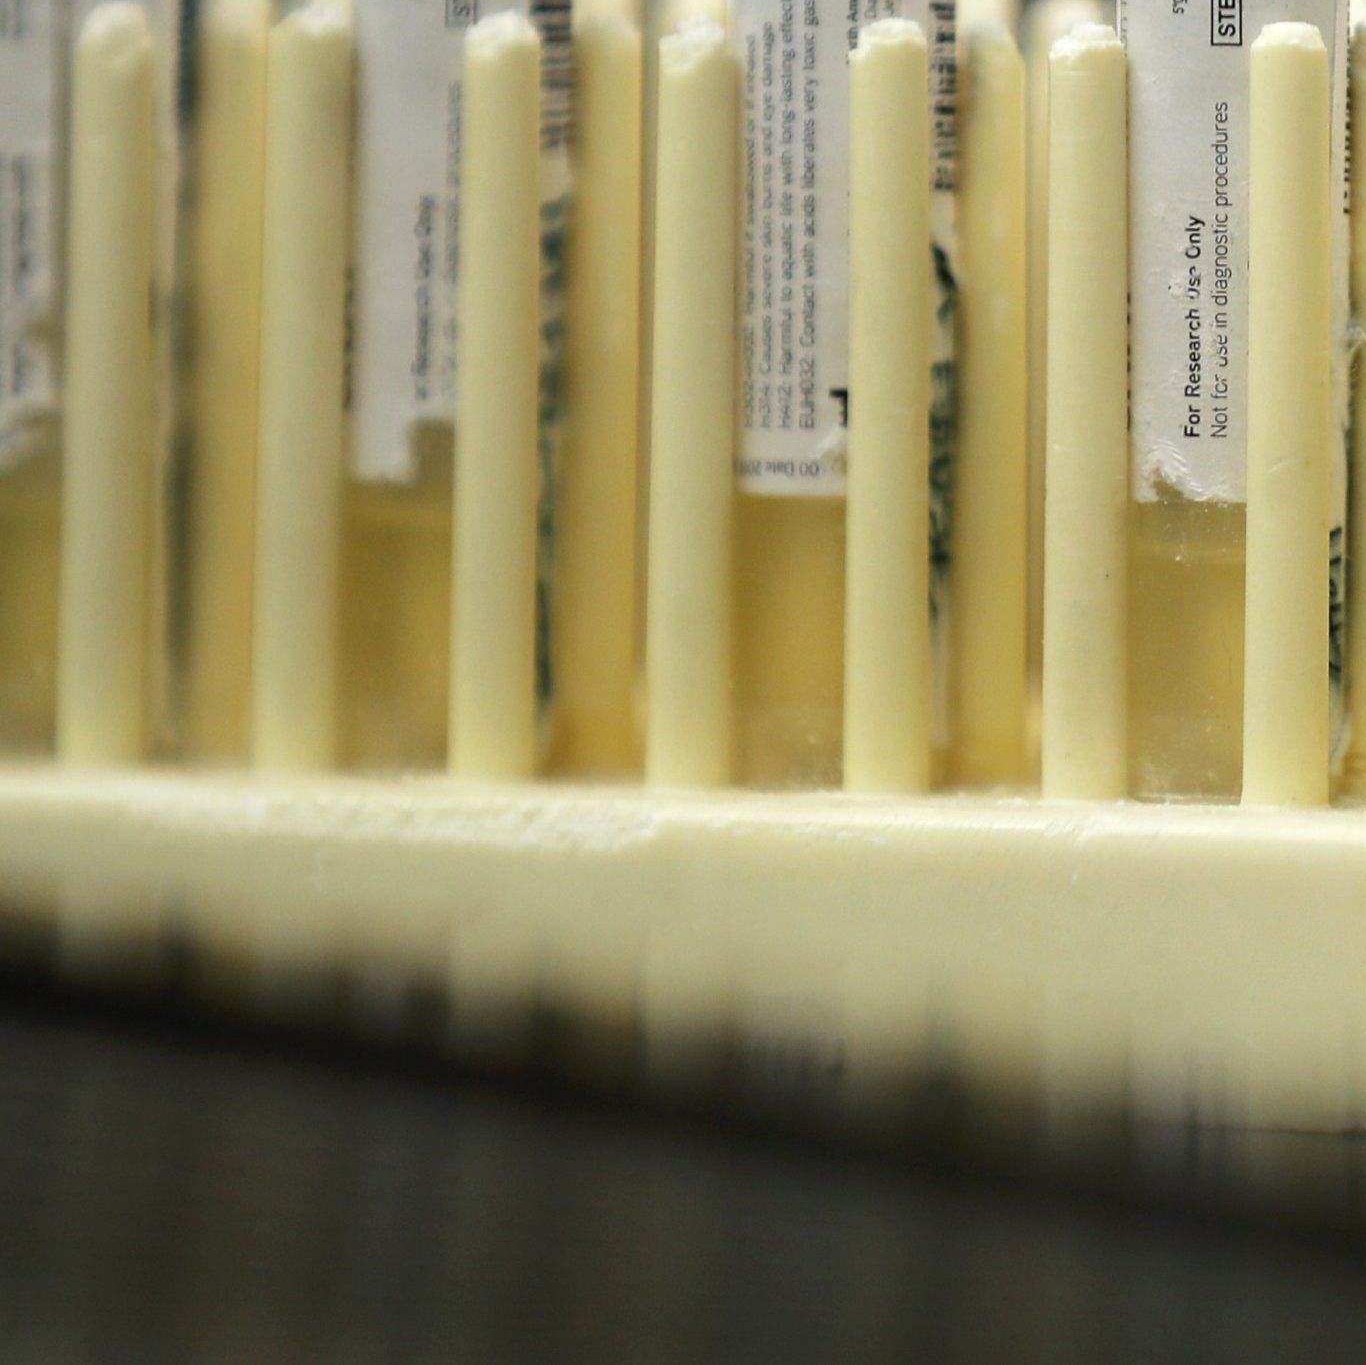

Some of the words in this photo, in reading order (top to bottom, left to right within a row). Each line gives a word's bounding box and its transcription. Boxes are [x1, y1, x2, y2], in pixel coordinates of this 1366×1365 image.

[761, 22, 775, 88] damage
[801, 33, 816, 70] toxic
[779, 49, 795, 145] long-lasting
[803, 79, 818, 113] very
[761, 127, 773, 156] and
[799, 120, 816, 189] liberates
[1210, 101, 1232, 207] procedures
[779, 151, 792, 186] with
[779, 192, 792, 216] life
[799, 196, 815, 238] acids
[779, 223, 795, 281] aquatic
[1184, 215, 1206, 259] Only
[799, 243, 815, 278] with
[1210, 213, 1232, 307] diagnostic
[780, 287, 792, 303] to
[799, 284, 815, 348] Contact
[1210, 312, 1228, 328] in
[779, 308, 792, 375] Harmful
[1184, 309, 1201, 398] Research
[1213, 335, 1228, 367] use
[1210, 374, 1228, 399] for
[1184, 405, 1201, 438] For
[1210, 407, 1228, 438] Not
